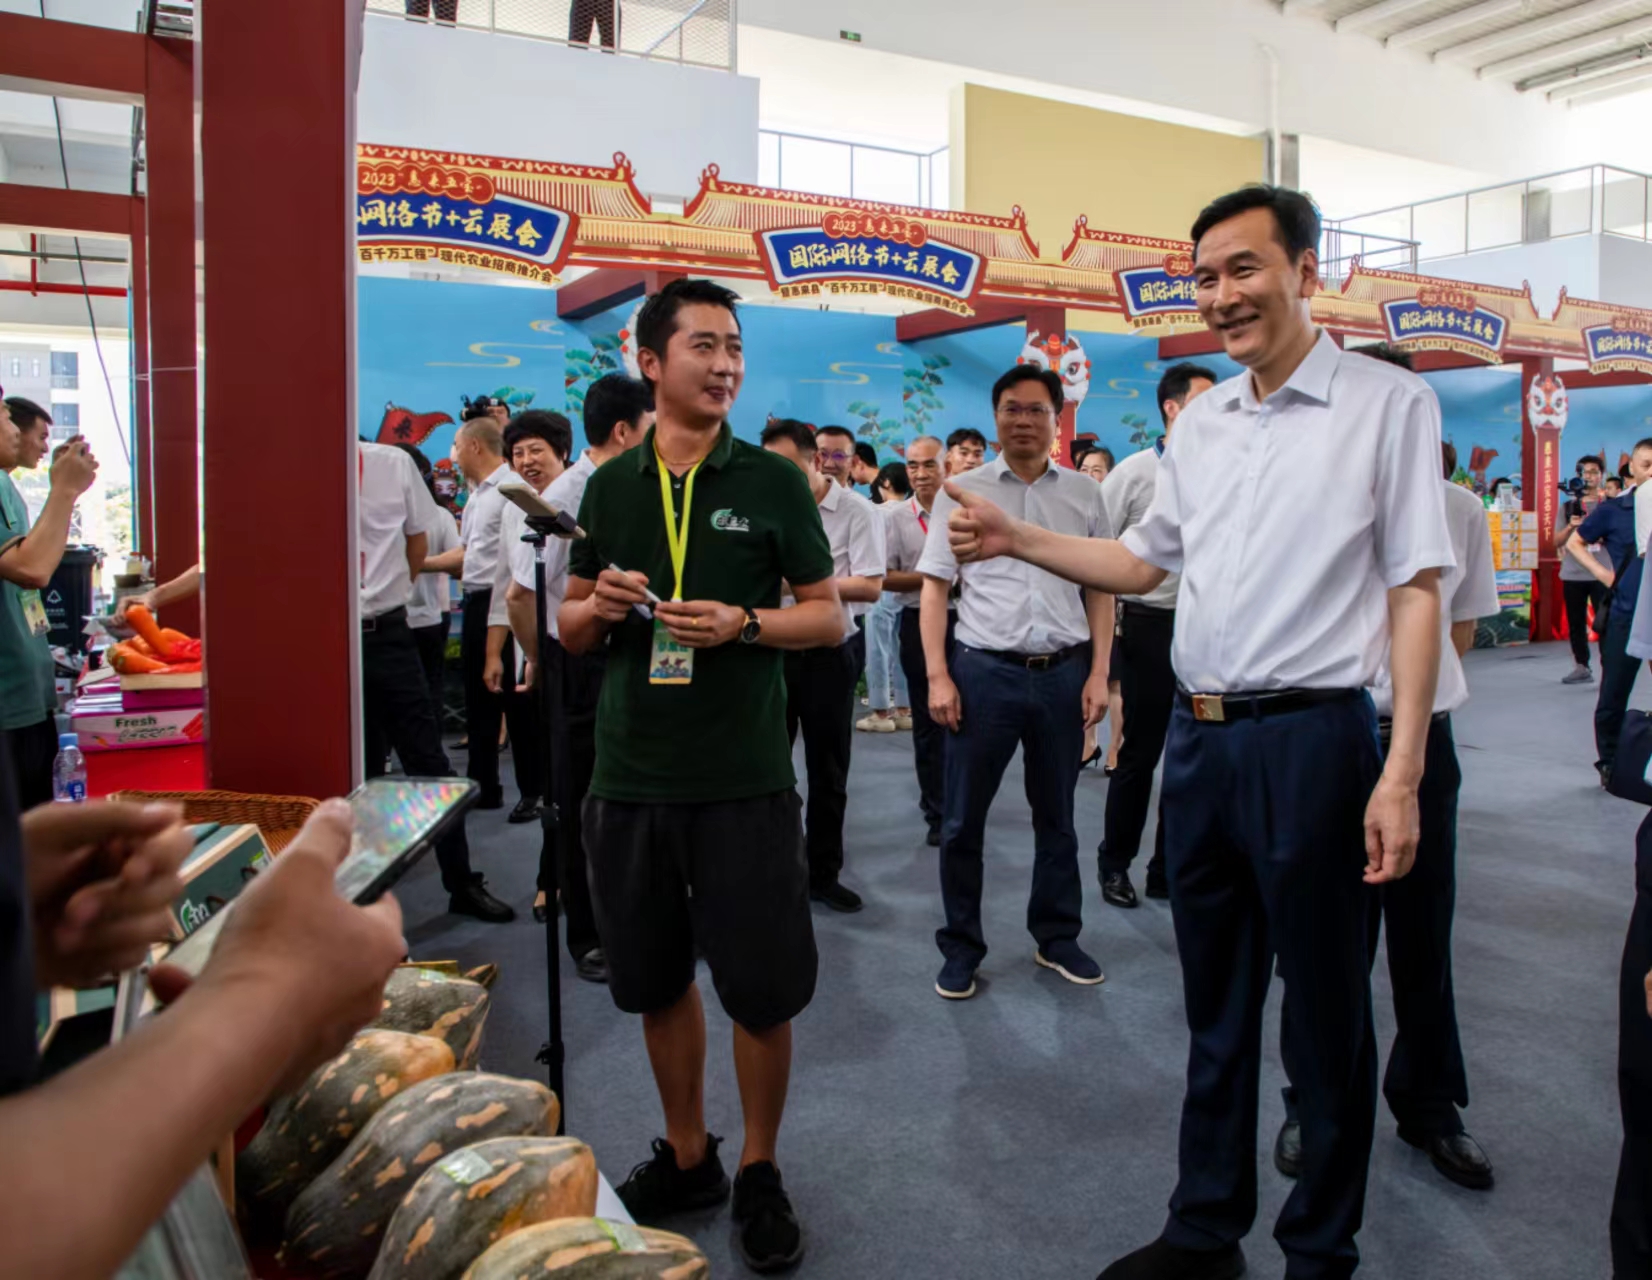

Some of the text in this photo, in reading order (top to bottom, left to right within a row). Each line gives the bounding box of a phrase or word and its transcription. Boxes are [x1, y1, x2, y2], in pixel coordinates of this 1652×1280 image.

[788, 242, 961, 285] 国际网络节+云展会
[114, 716, 157, 728] Fresh
